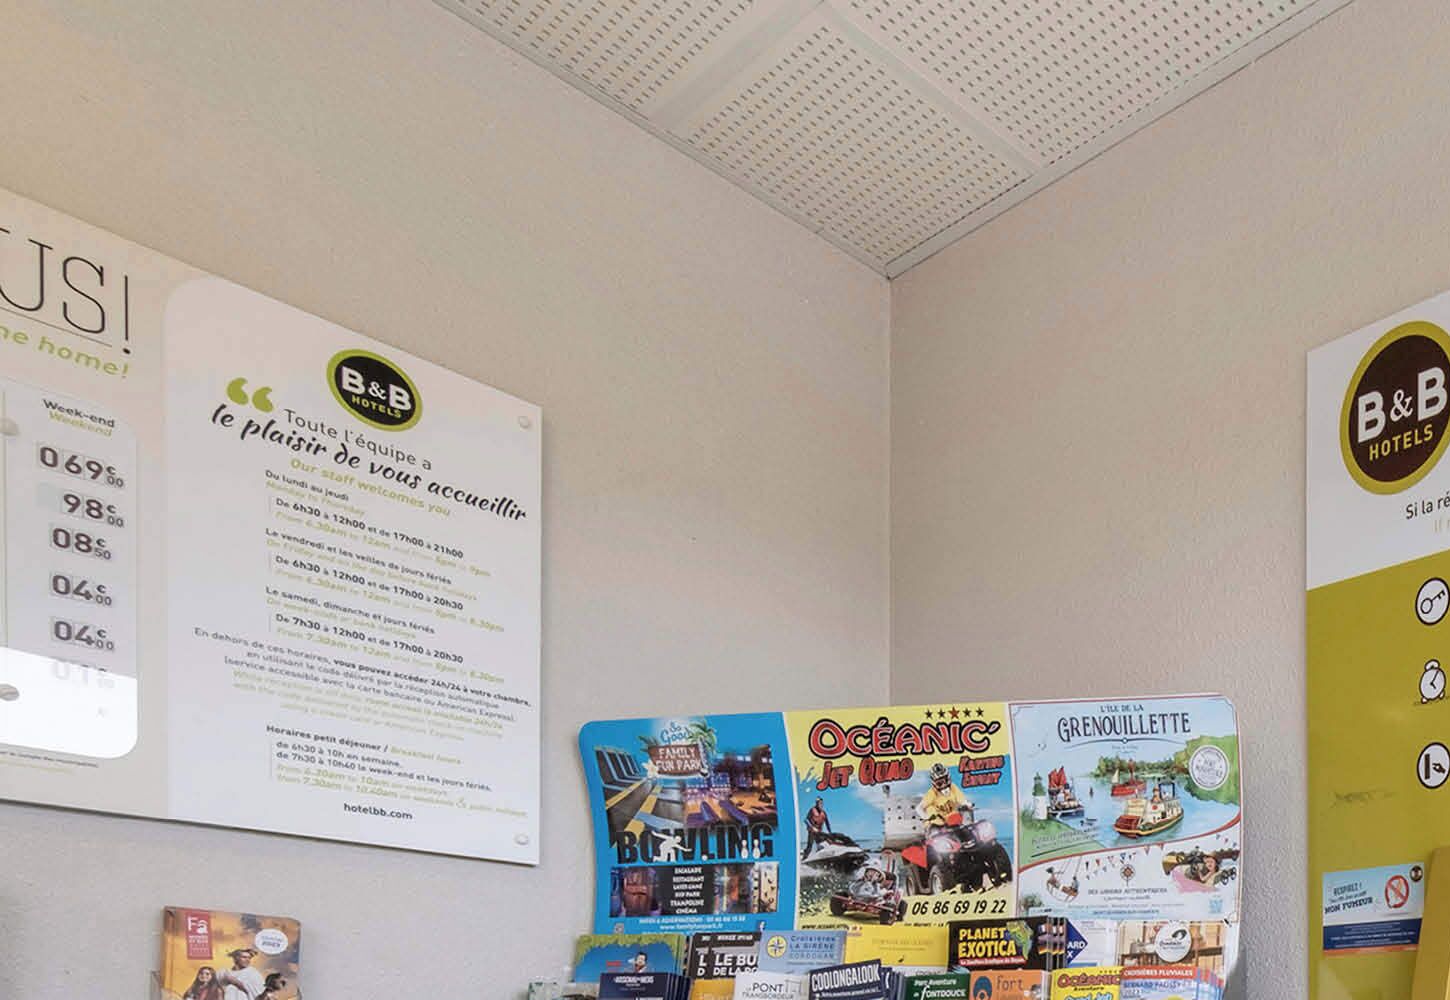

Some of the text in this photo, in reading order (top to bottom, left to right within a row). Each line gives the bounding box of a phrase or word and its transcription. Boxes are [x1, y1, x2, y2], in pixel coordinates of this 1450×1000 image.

[38, 336, 130, 378] home!
[341, 365, 412, 411] B&B
[43, 399, 115, 428] Week-end
[351, 394, 402, 419] HOTELS
[1357, 366, 1448, 444] B&B
[284, 408, 432, 470] Toute l'équipe a
[1368, 423, 1434, 461] HOTELS
[212, 403, 528, 522] le plaisir de vous accueillir
[282, 474, 308, 489] lundi
[290, 458, 318, 474] Our
[321, 469, 356, 487] staff
[357, 481, 425, 508] welcomes
[428, 503, 451, 517] you
[1405, 502, 1418, 521] Si
[1421, 498, 1433, 516] la
[1057, 712, 1191, 743] GRENOUILLETTE
[655, 759, 674, 771] FUN
[658, 746, 696, 760] FAMILY
[343, 802, 413, 821] hotelbb.com
[911, 899, 1007, 916] 06 86 69 19 22
[958, 926, 1006, 940] PLANET
[958, 938, 1017, 957] EXOTICA
[752, 982, 784, 993] PONT
[811, 962, 881, 993] COOLONGALOOK
